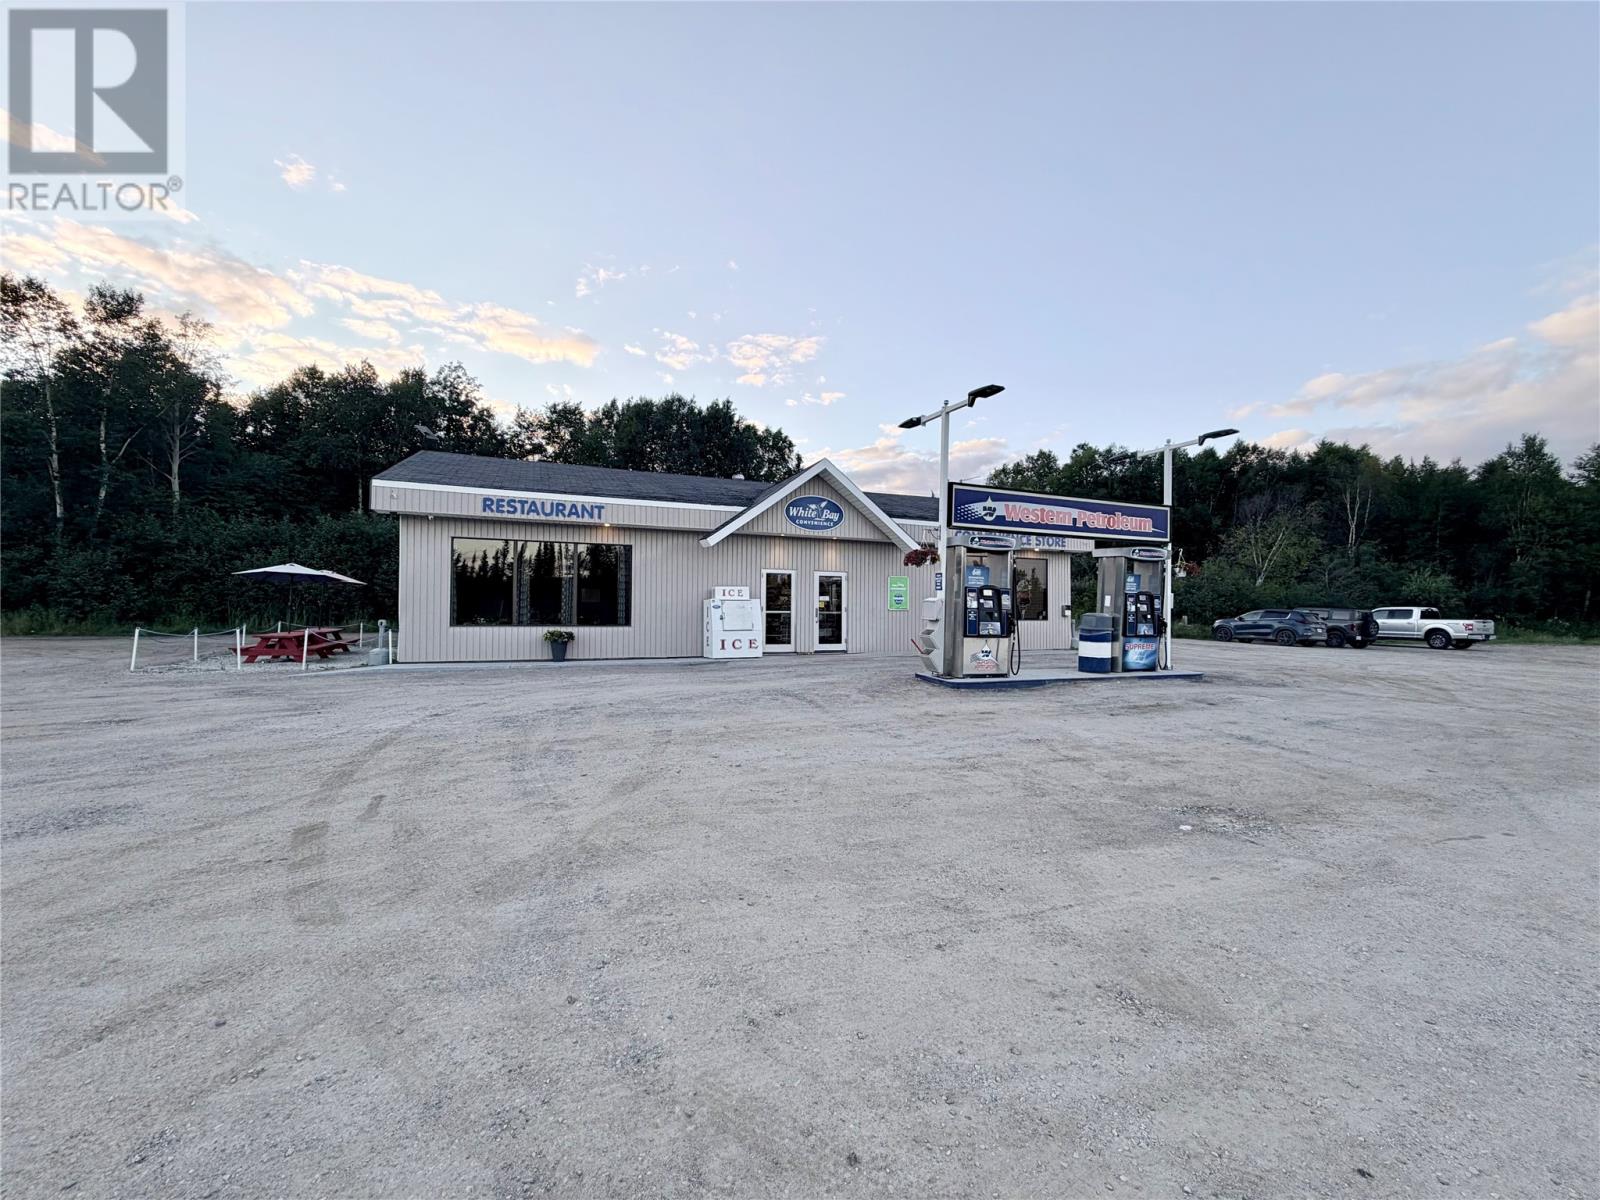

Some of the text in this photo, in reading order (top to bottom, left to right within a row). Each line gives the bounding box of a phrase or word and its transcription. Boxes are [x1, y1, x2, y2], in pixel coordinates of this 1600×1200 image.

[482, 496, 605, 521] RESTAURANT
[789, 506, 840, 522] White Bay
[795, 519, 834, 527] CONVENIENCE
[1004, 503, 1153, 533] Western Petroleum
[1035, 537, 1066, 548] STORE
[722, 589, 744, 597] ICE
[720, 638, 759, 651] ICE
[1125, 643, 1156, 651] SUPREME
